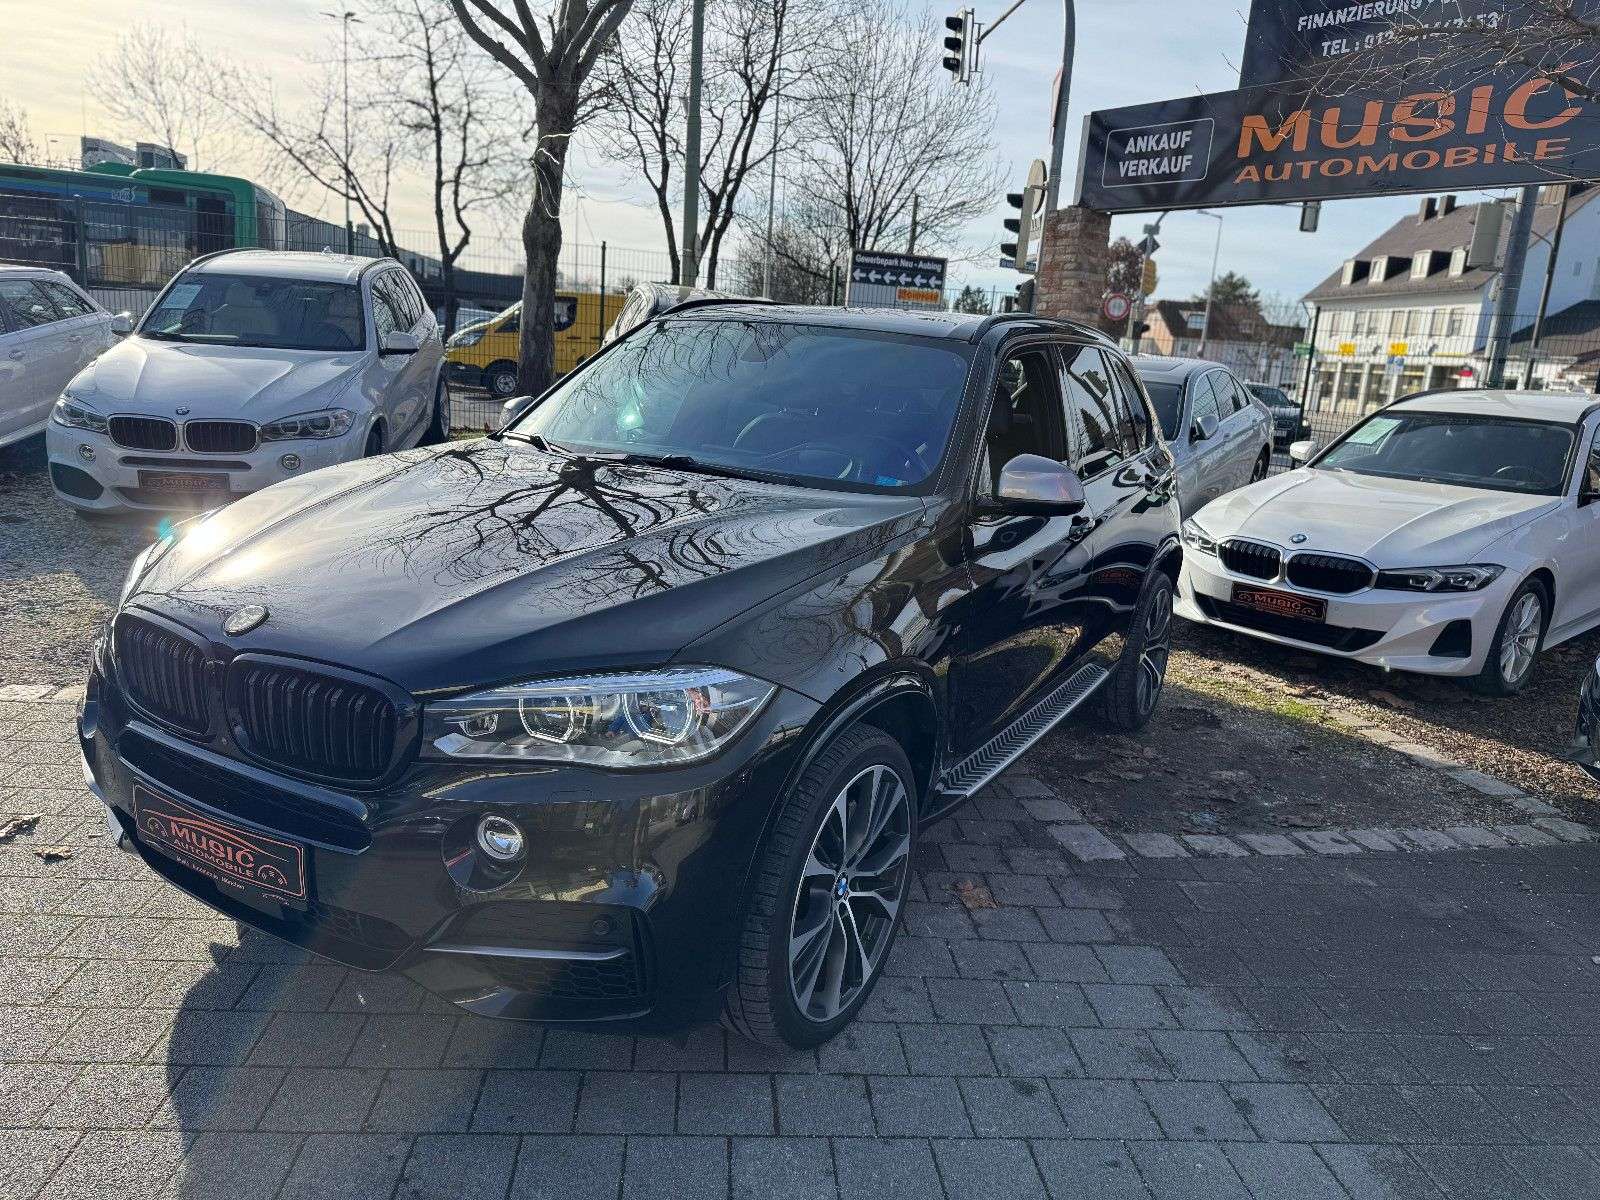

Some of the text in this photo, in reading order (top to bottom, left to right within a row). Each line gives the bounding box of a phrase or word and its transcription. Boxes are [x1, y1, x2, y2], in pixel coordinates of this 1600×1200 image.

[1124, 130, 1192, 154] ANKAUF
[1119, 155, 1193, 177] VERKAUF
[1233, 138, 1571, 184] AUTOMOBILE
[173, 839, 253, 878] AUTOMOBILE
